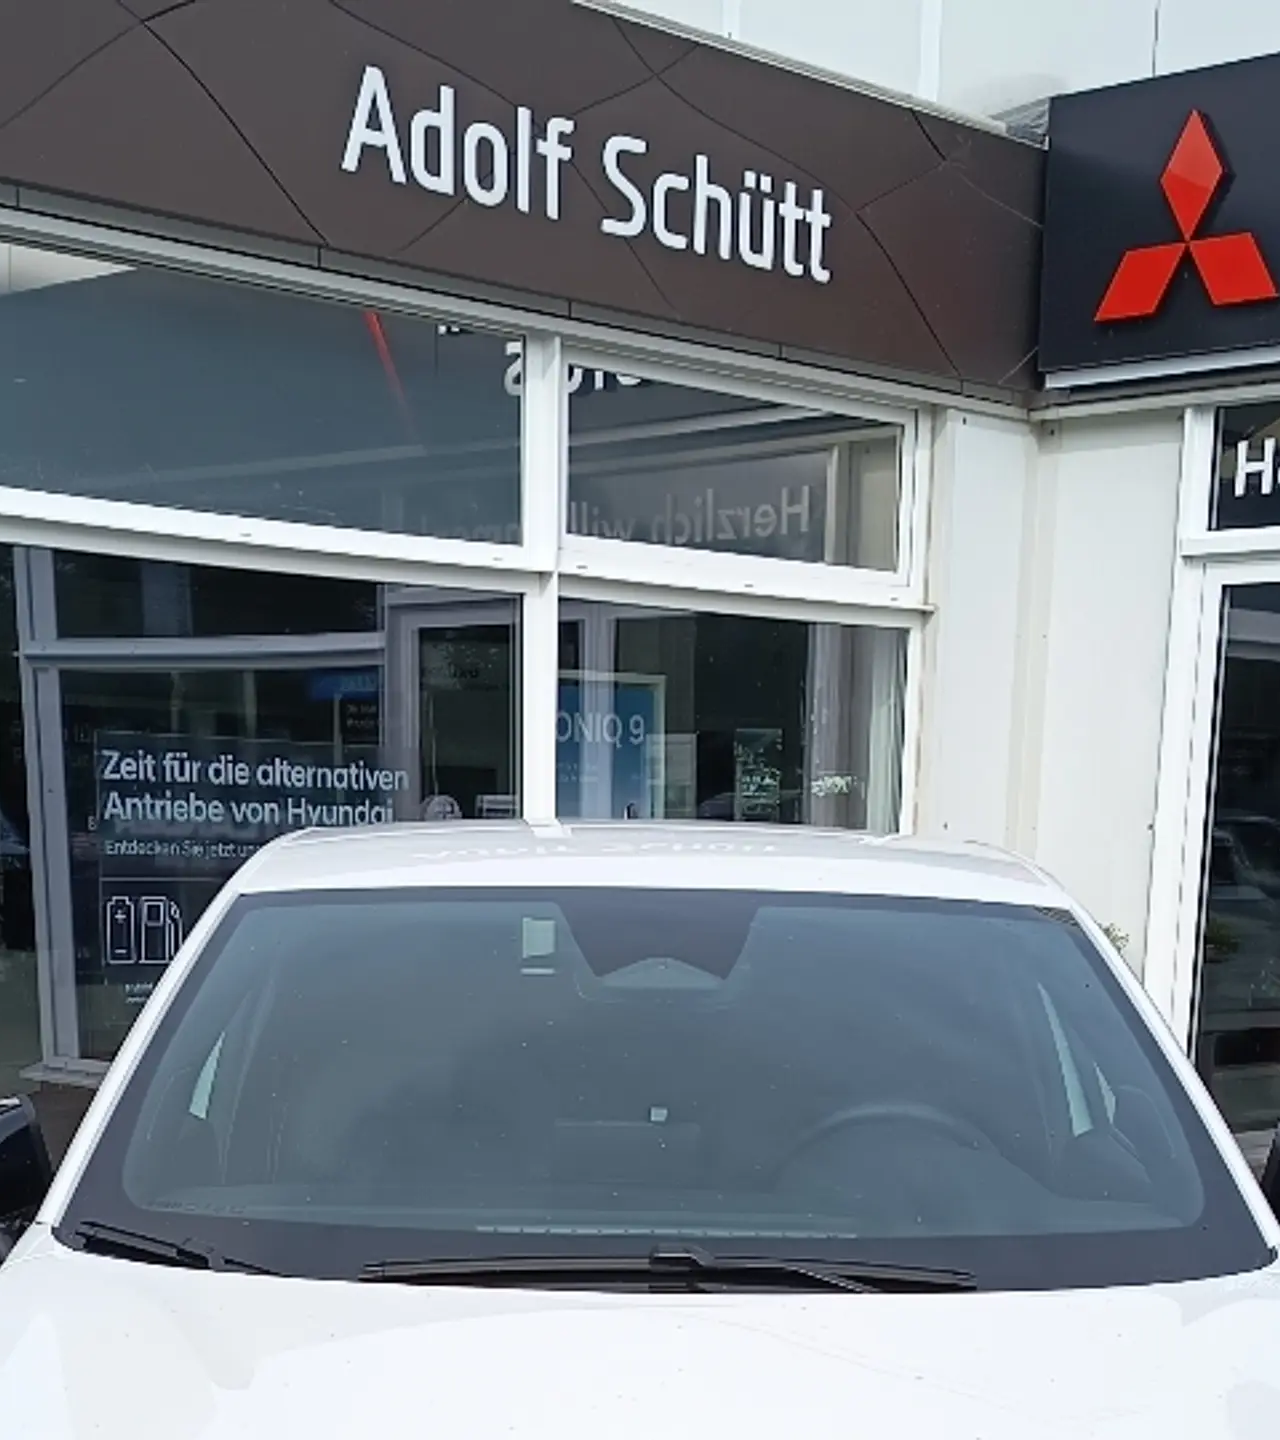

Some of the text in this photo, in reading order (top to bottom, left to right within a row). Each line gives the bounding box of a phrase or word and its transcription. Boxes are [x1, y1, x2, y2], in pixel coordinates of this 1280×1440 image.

[340, 64, 833, 285] Adolf Schütt
[628, 713, 645, 745] 9
[100, 749, 410, 791] Zeit für die alternativen
[103, 790, 394, 828] Antriebe von Hyundai
